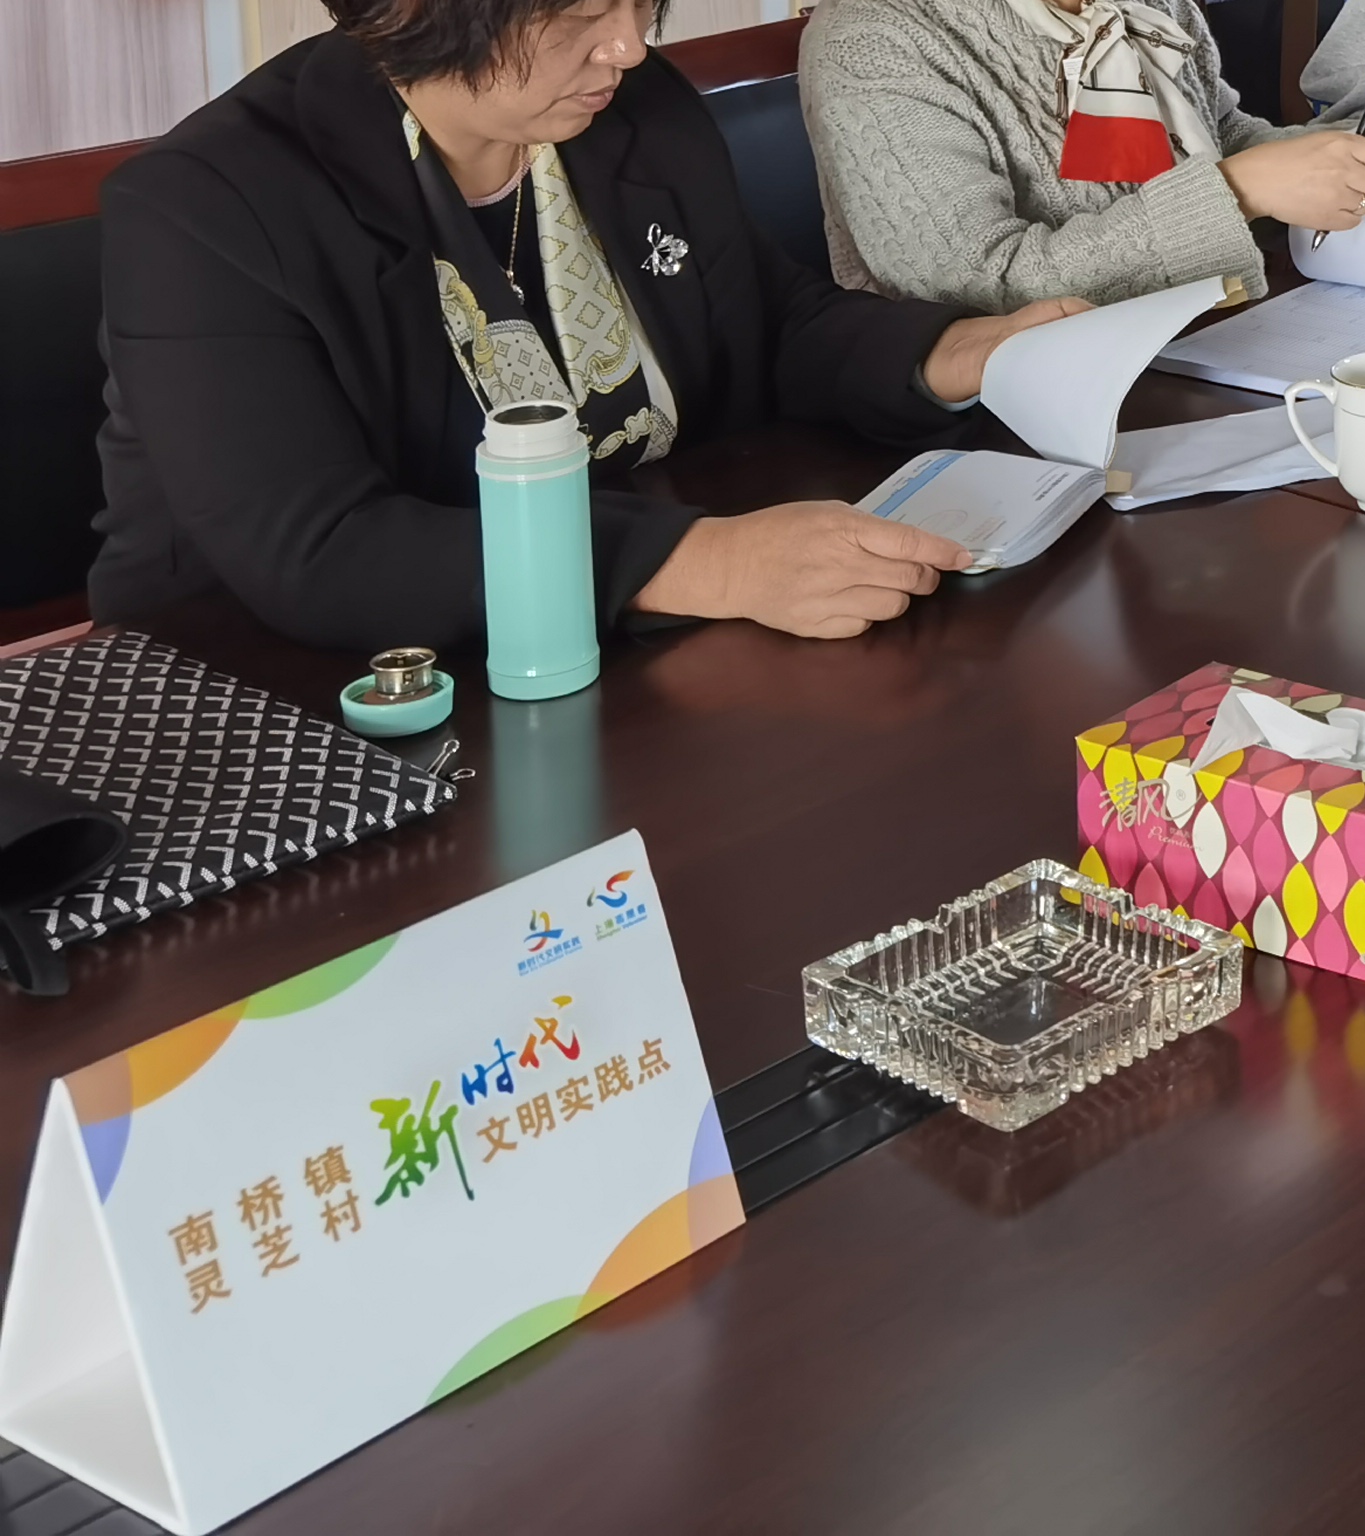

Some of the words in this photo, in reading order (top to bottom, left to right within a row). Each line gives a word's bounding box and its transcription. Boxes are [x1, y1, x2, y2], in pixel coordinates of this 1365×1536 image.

[1099, 777, 1202, 832] 清风
[1148, 826, 1205, 852] Premium
[369, 994, 585, 1209] 新时代
[474, 1036, 674, 1166] 文明实践点
[166, 1143, 354, 1266] 南桥镇
[185, 1191, 363, 1316] 灵芝村
